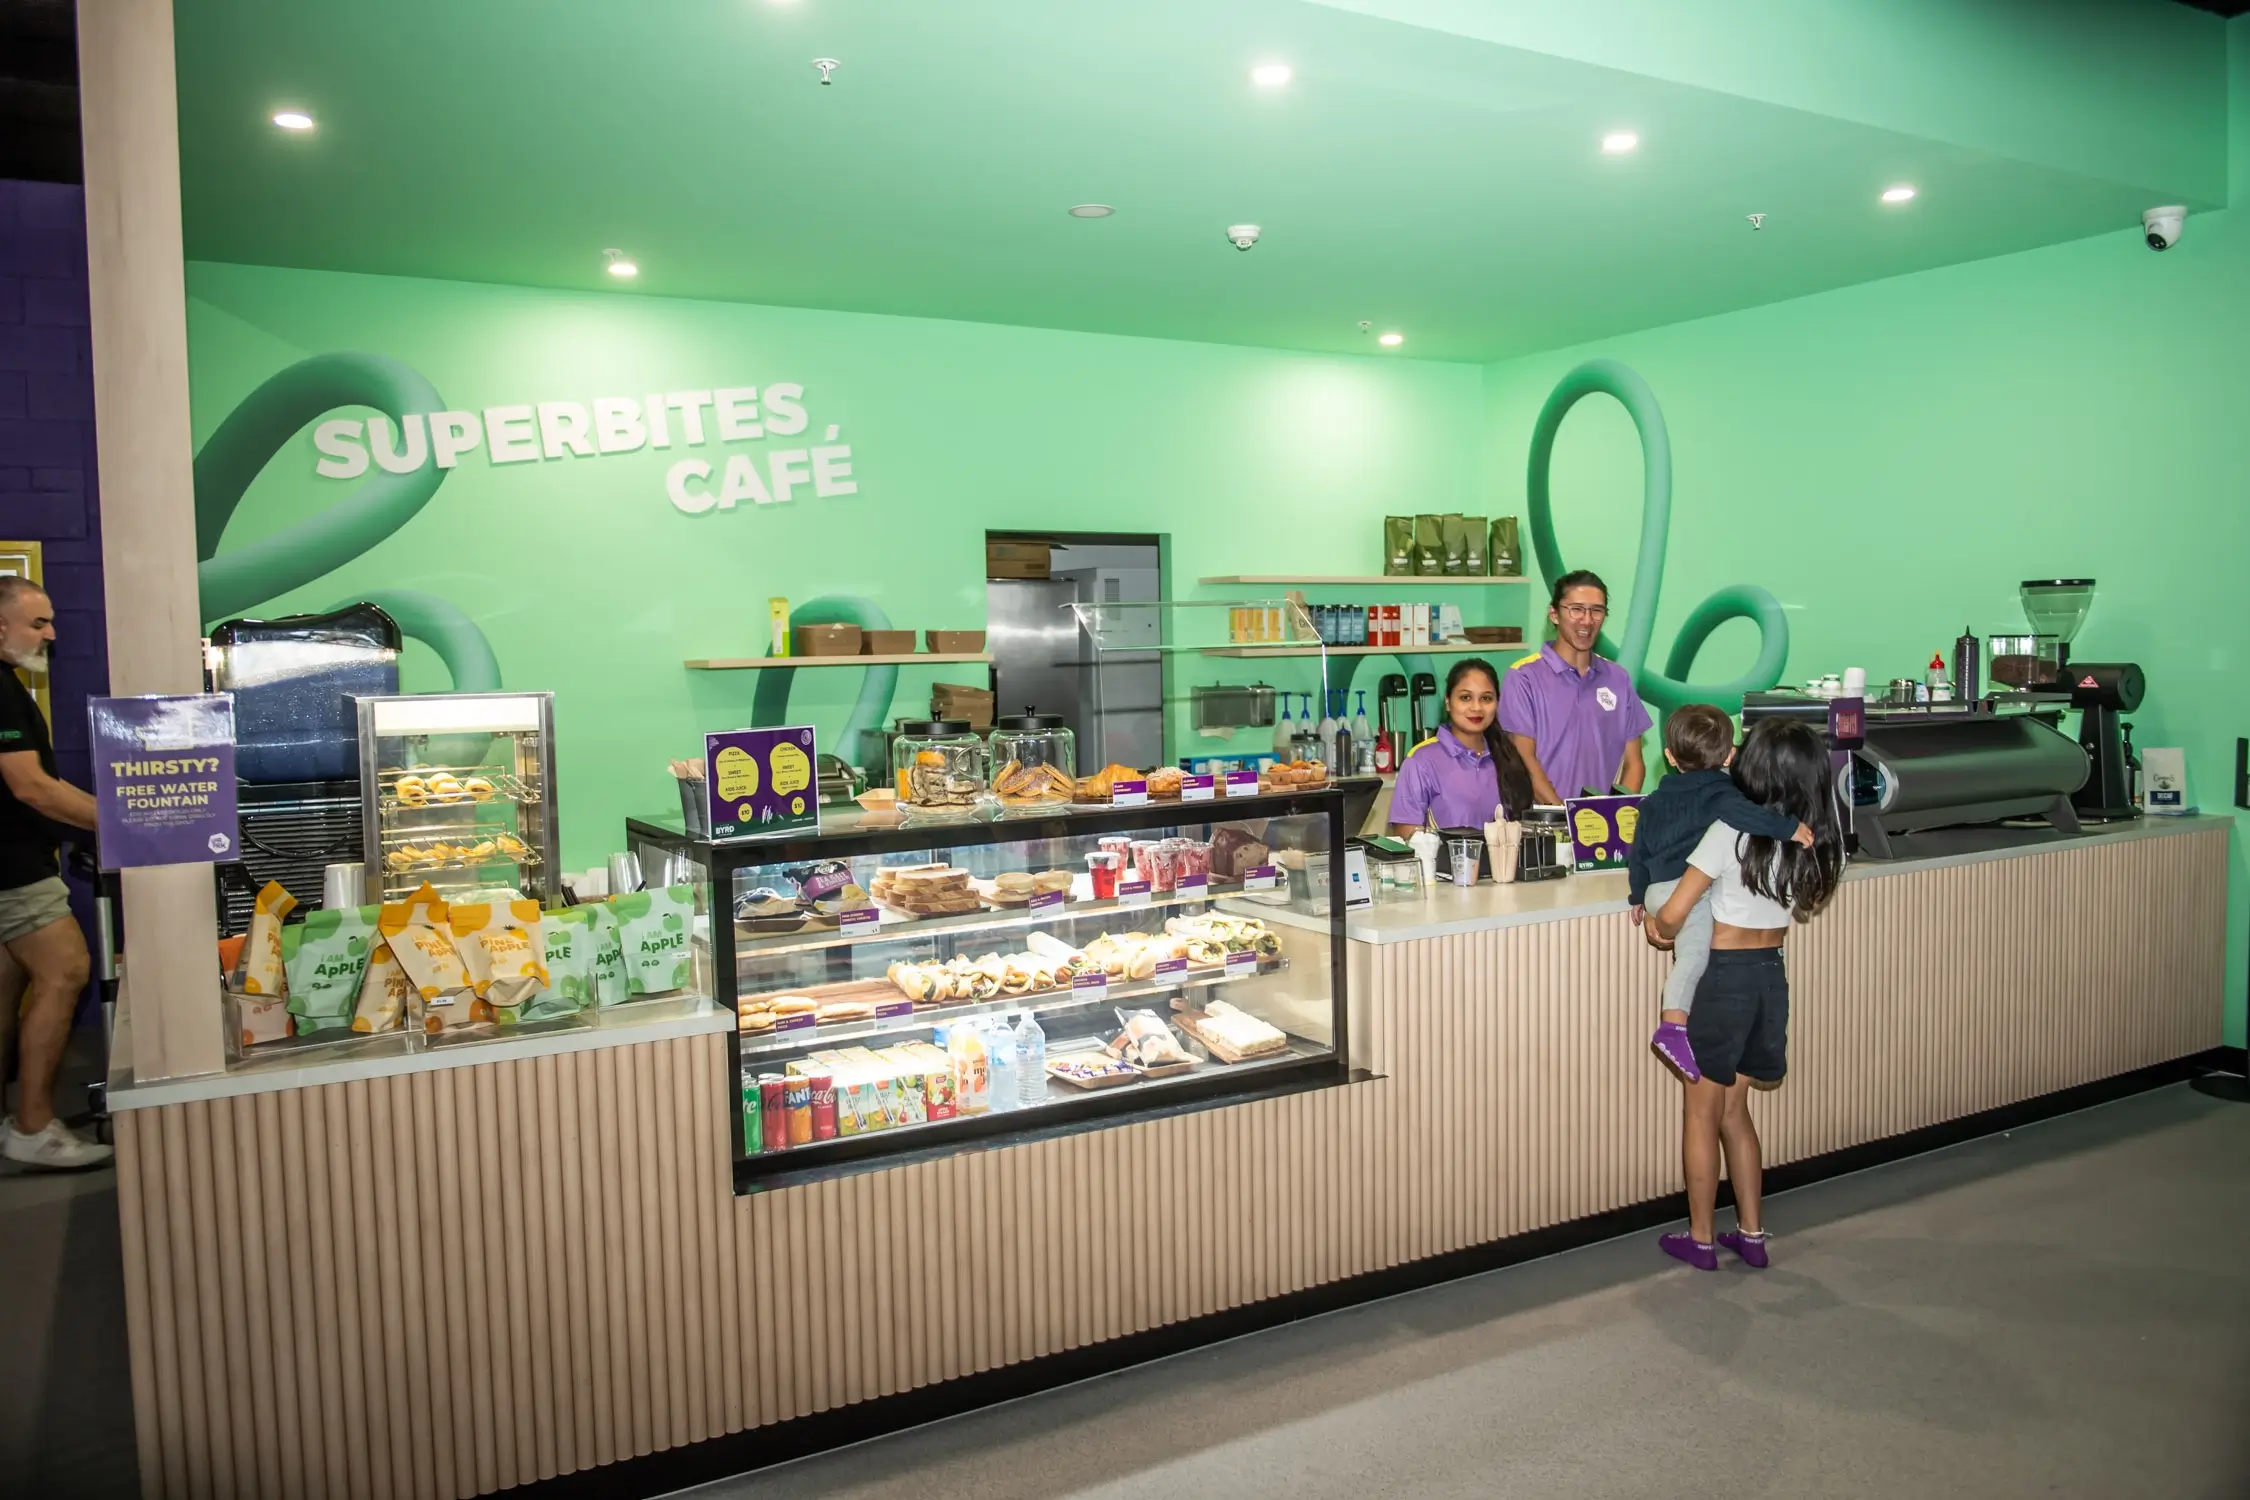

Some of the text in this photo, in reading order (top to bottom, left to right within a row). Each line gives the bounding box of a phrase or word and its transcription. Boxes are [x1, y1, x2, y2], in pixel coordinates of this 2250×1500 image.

[314, 382, 809, 479] SUPERBITES
[666, 423, 858, 514] CAFÉ
[111, 757, 220, 778] THIRSTY?
[116, 781, 218, 798] FREE WATER
[127, 794, 209, 810] FOUNTAIN
[715, 825, 735, 835] BYRD
